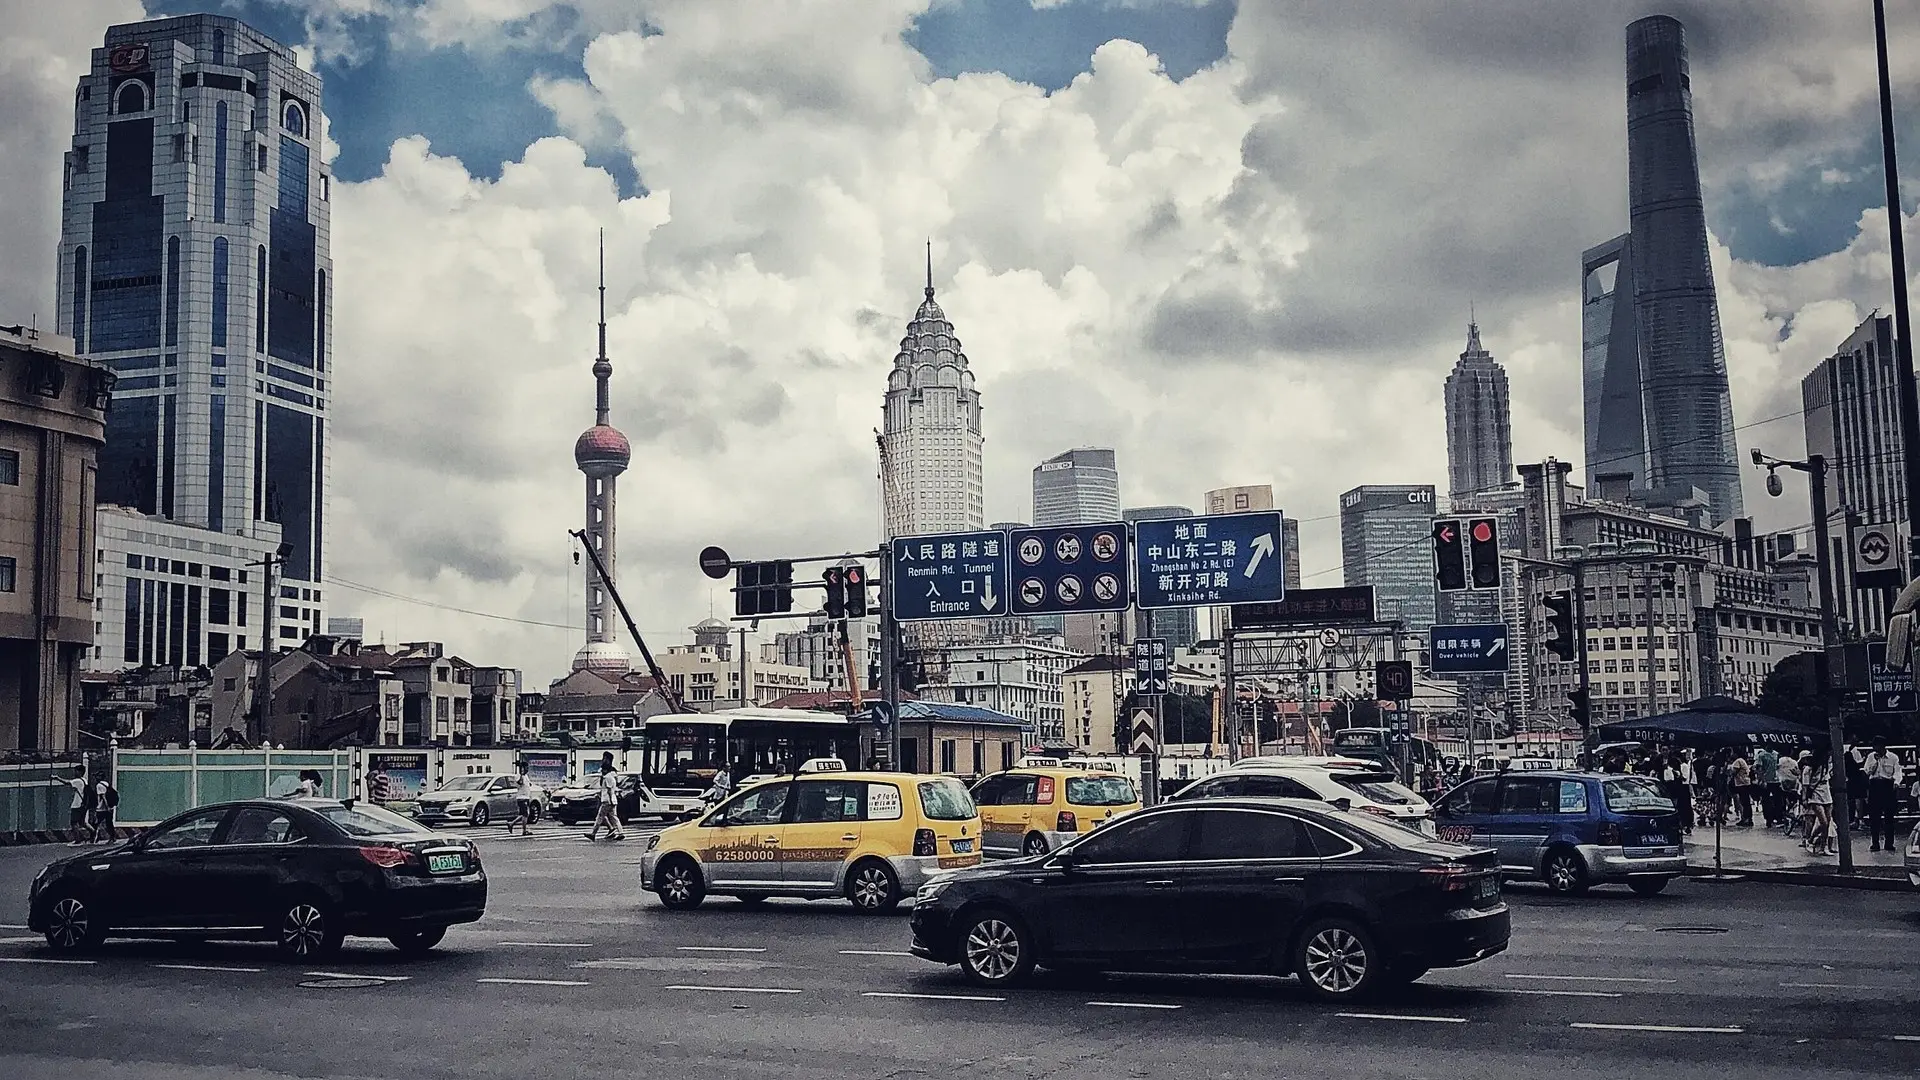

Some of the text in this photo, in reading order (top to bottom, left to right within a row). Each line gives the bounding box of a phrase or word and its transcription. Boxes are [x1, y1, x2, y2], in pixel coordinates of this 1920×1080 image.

[1408, 490, 1431, 503] citi
[1175, 523, 1207, 540] 地面
[900, 540, 999, 562] 人民路隧道
[1023, 545, 1040, 556] 40
[1148, 540, 1237, 560] 中山东二路
[908, 562, 994, 577] Renmin Rd. Tunnel
[1151, 562, 1188, 573] Zhongshan
[1203, 560, 1208, 569] 2
[1223, 559, 1234, 568] (E)
[1159, 571, 1229, 590] 新开河路
[925, 580, 975, 597] 入口
[1168, 591, 1222, 602] Xinkaihe Rd.
[930, 601, 970, 613] Entrance
[1137, 643, 1150, 671] 隧道
[1153, 643, 1165, 671] 豫园
[1386, 672, 1403, 687] 40
[1635, 730, 1664, 741] POLICE
[1761, 733, 1799, 744] POLICE
[715, 850, 774, 861] 62580000
